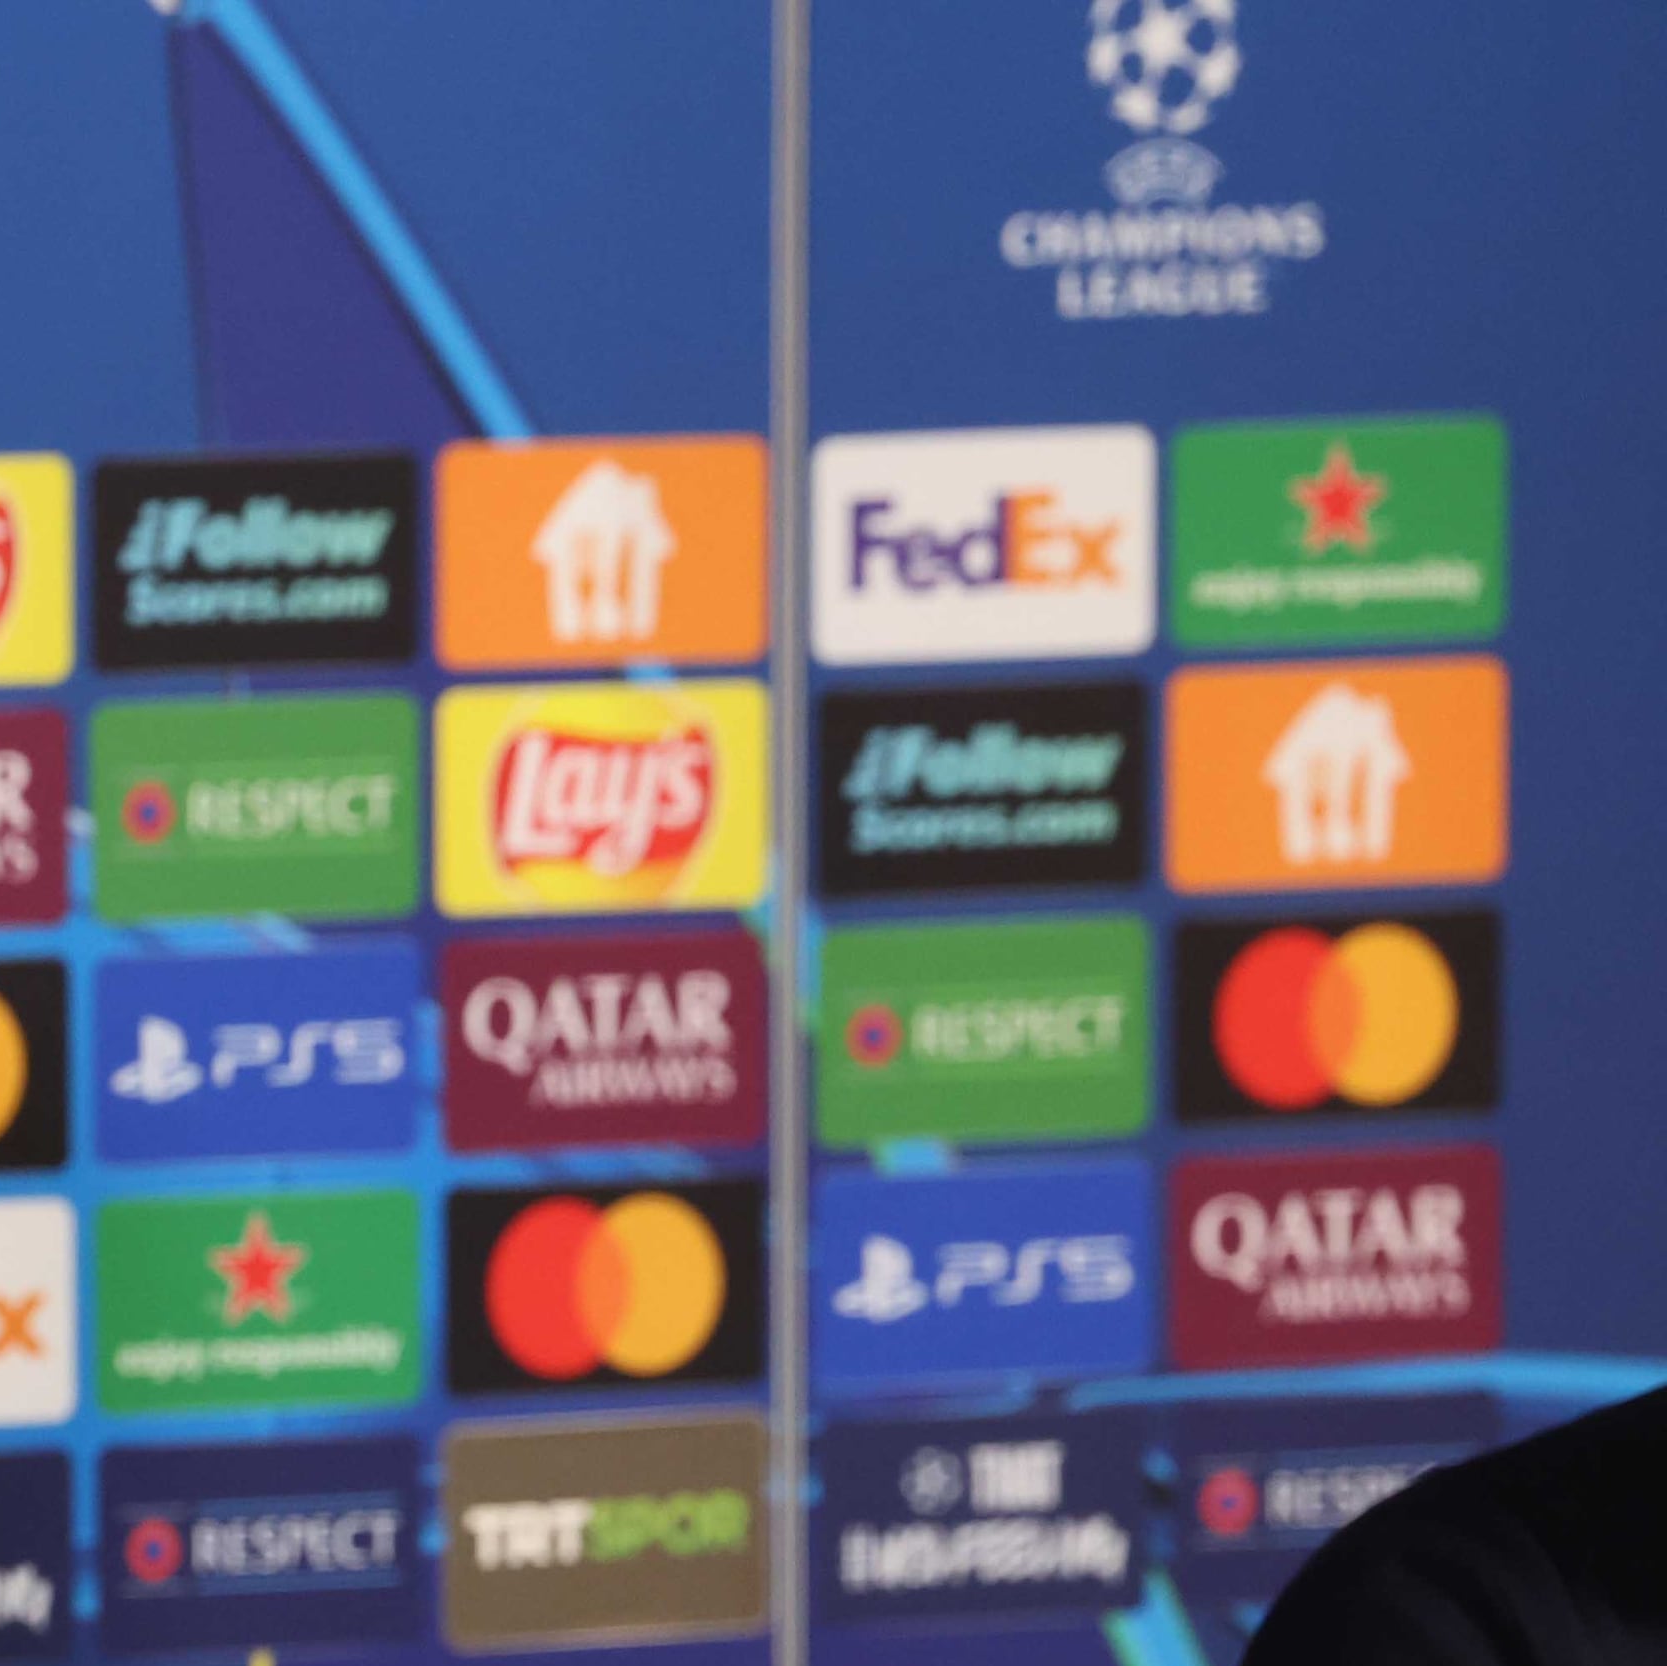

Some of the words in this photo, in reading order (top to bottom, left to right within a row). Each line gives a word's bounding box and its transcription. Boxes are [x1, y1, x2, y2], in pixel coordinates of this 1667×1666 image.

[1000, 202, 1325, 268] CHAMPIONS
[1057, 262, 1271, 320] LEAGUE
[849, 486, 1123, 593] FedEx
[184, 773, 398, 838] RESPECT
[499, 722, 708, 876] Lay's
[211, 1018, 407, 1089] PS5
[462, 969, 735, 1078] QATAR
[910, 993, 1130, 1066] RESPECT
[935, 1231, 1136, 1309] PS5
[1190, 1181, 1466, 1294] QATAR
[189, 1509, 398, 1577] RESPECT
